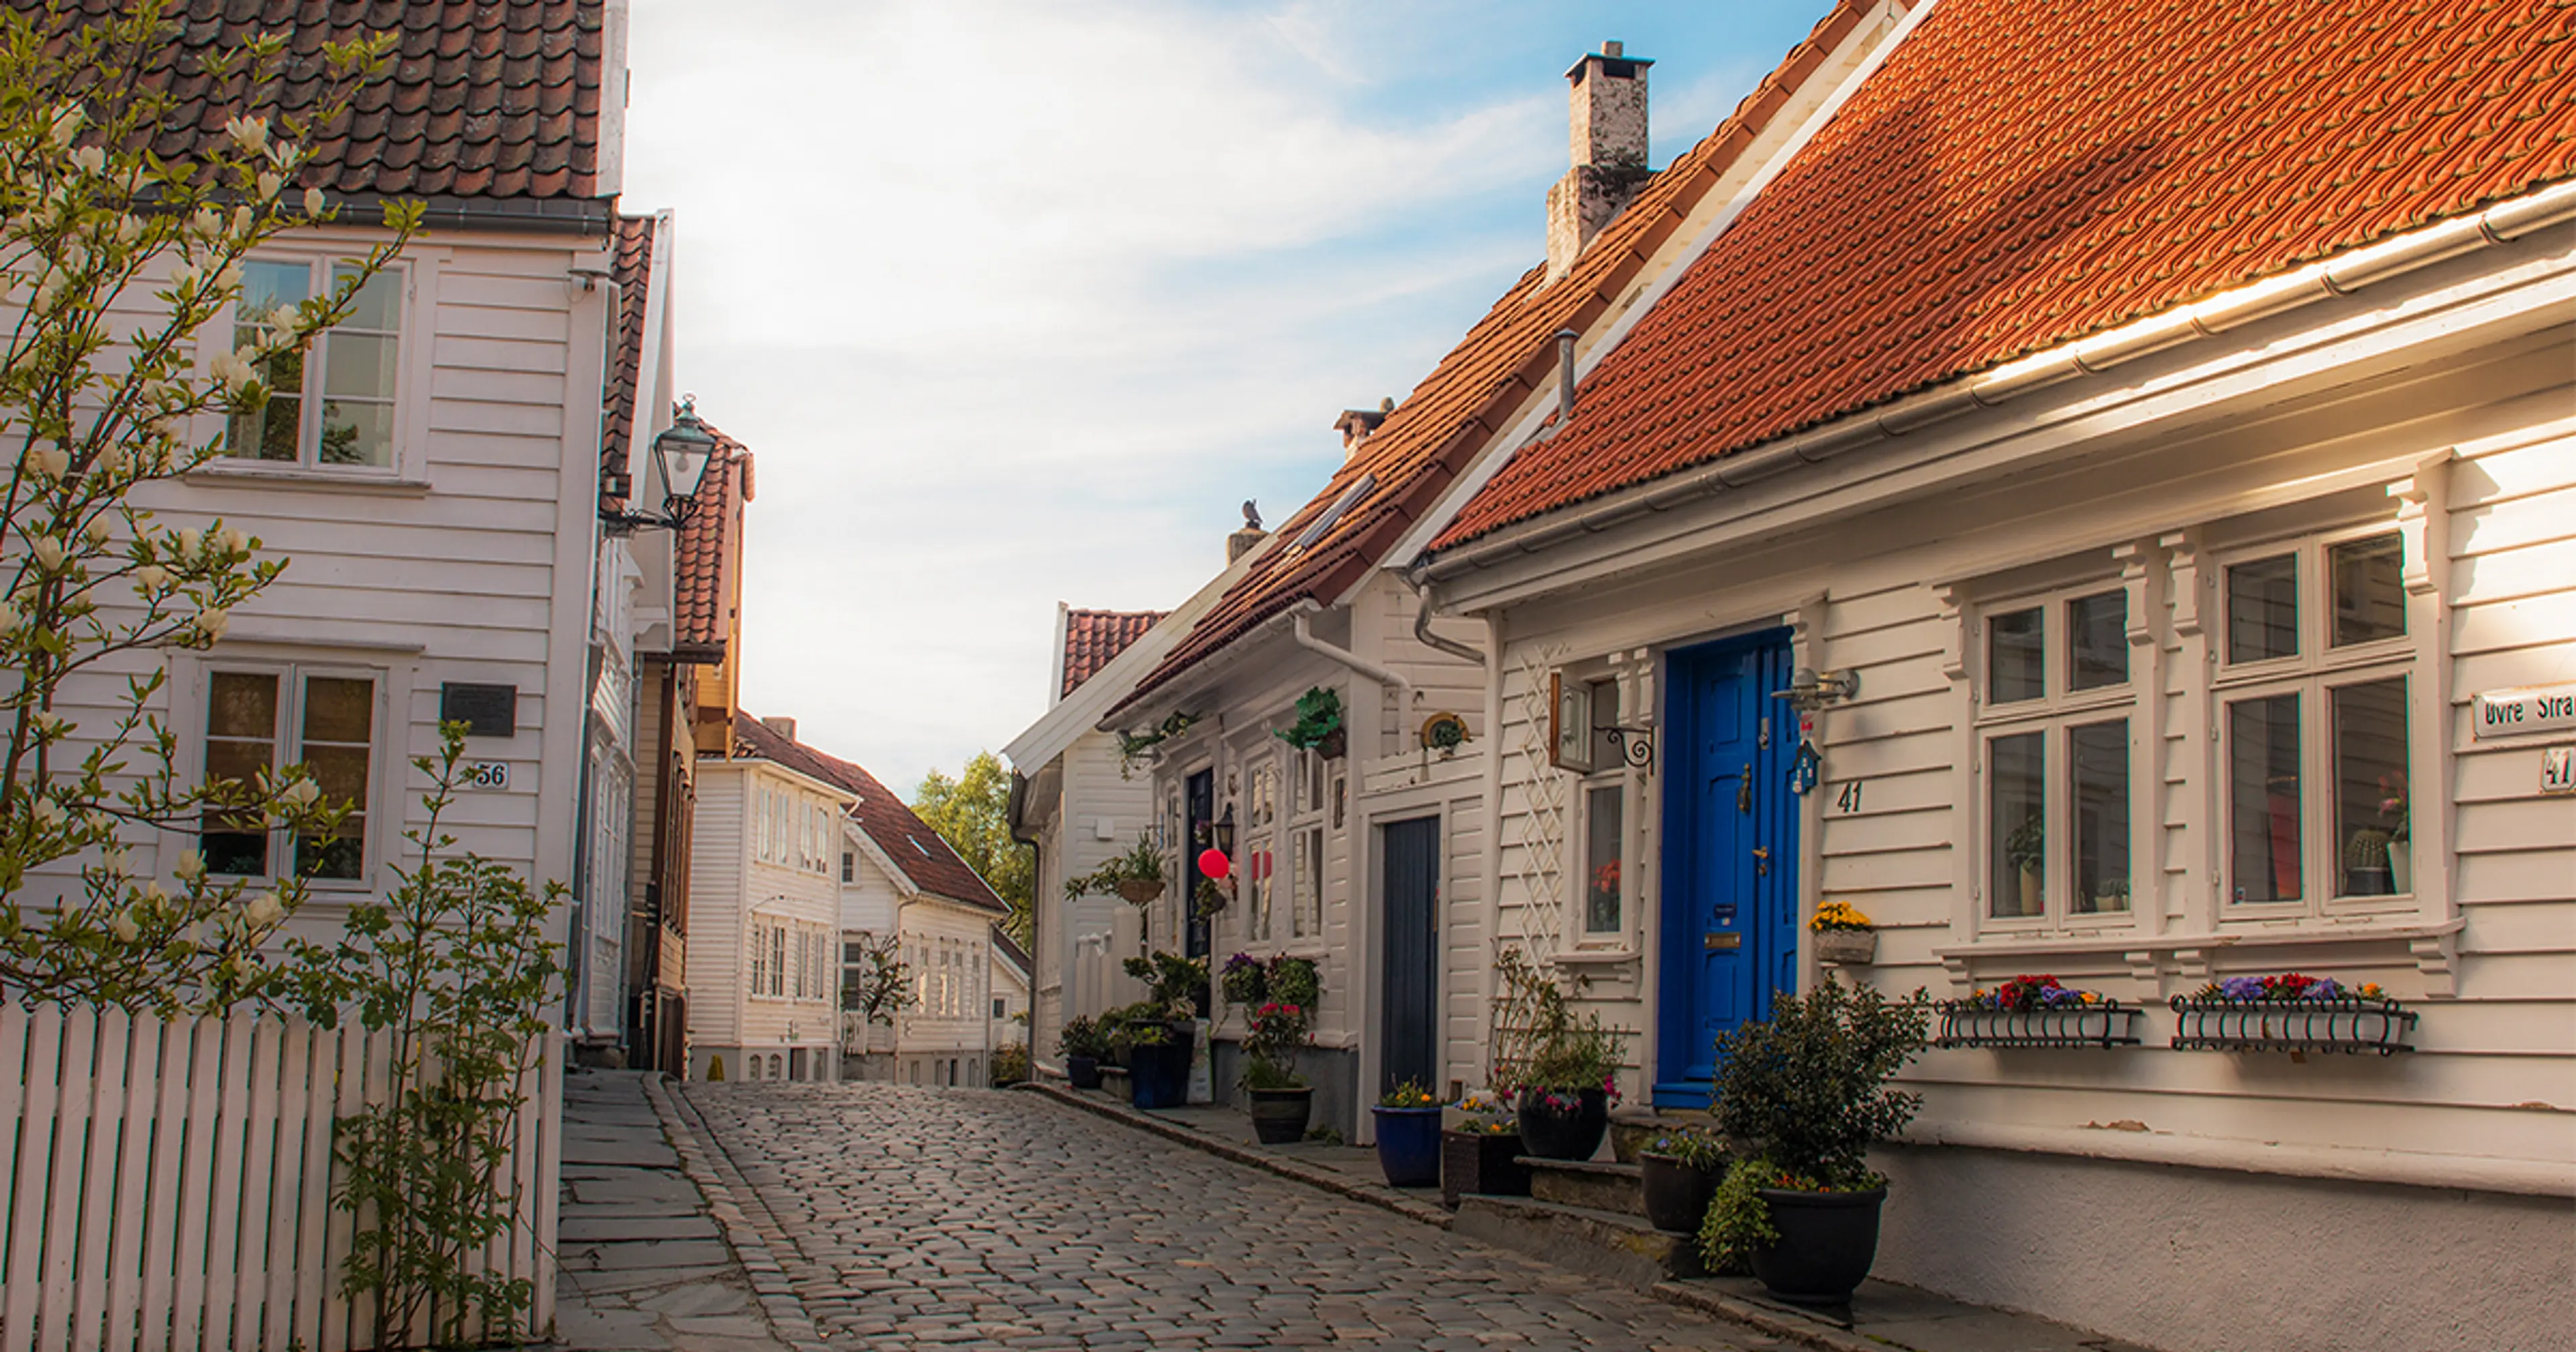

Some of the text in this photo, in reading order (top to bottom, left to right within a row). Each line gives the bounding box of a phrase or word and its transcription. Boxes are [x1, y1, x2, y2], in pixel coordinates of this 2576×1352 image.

[2536, 695, 2576, 718] Stra
[476, 763, 505, 785] 56
[2546, 750, 2571, 784] 41
[1837, 781, 1862, 813] 41
